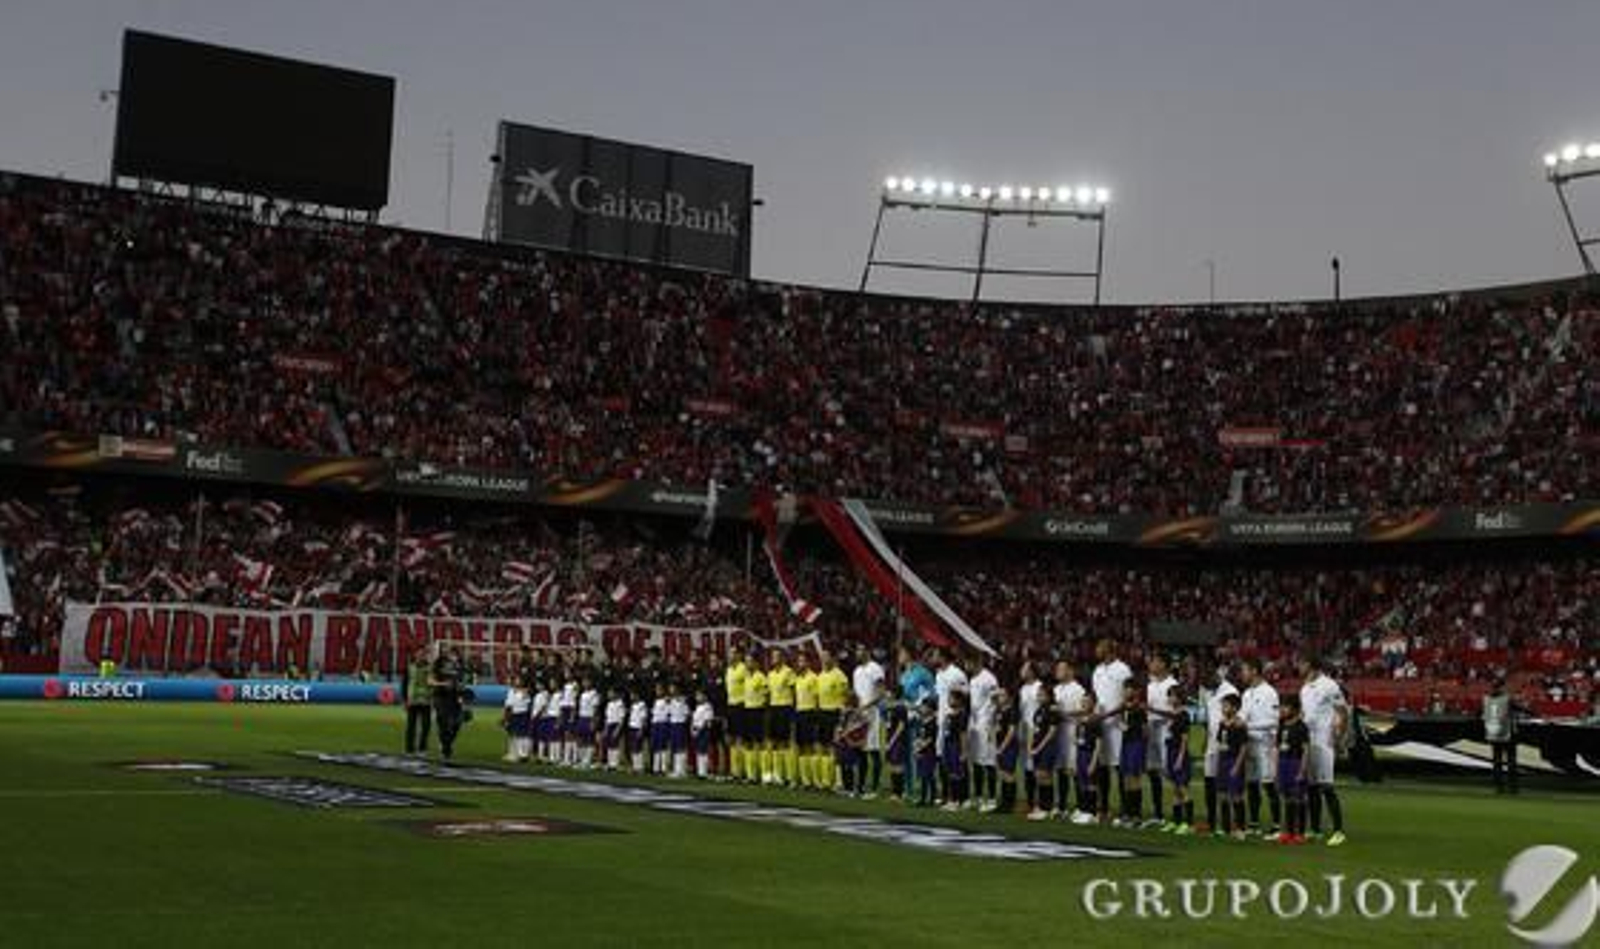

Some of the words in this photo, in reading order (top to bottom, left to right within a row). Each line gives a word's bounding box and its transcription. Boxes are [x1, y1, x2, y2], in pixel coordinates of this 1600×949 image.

[570, 174, 739, 237] CaixaBank
[85, 606, 312, 671] ONDEAN
[68, 681, 145, 699] RESPECT
[241, 684, 311, 702] RESPECT
